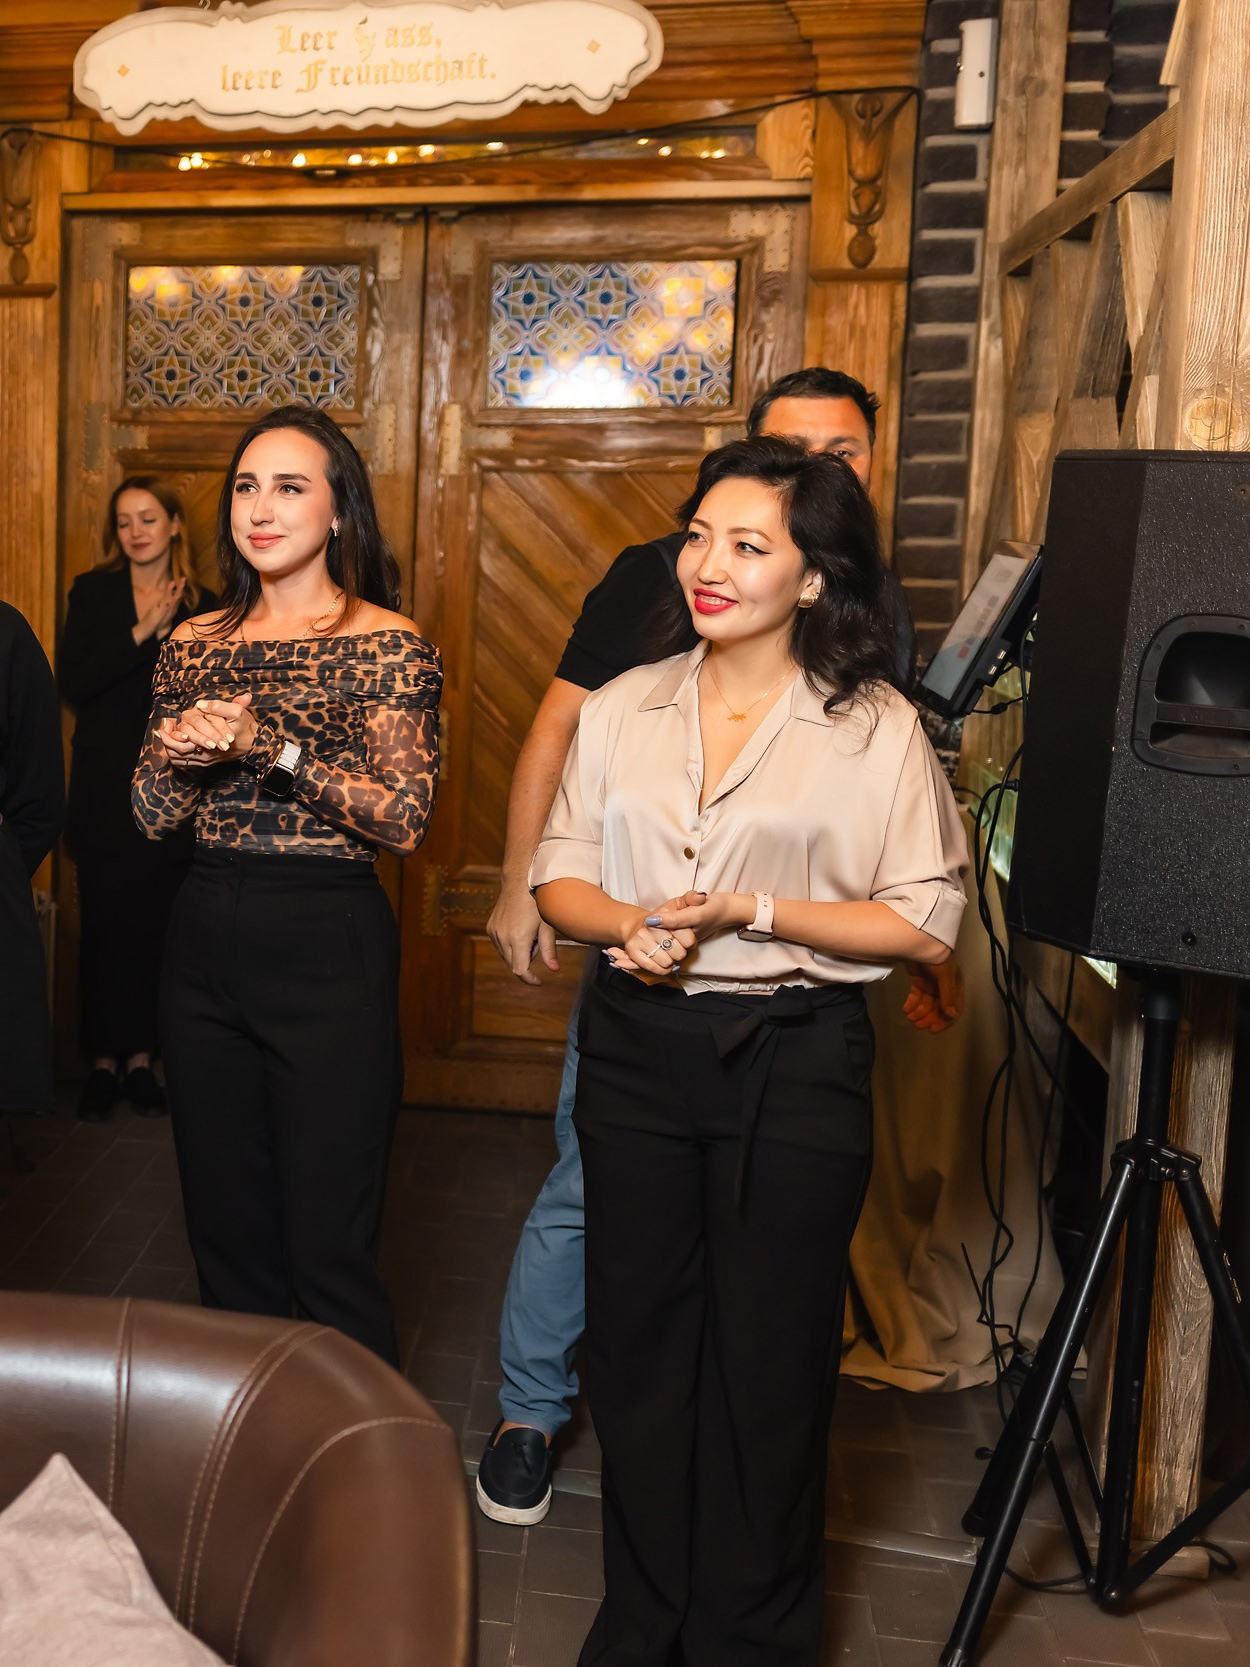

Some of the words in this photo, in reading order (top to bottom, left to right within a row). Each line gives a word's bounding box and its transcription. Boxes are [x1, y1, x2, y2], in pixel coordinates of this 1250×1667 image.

[274, 24, 338, 54] Leer
[221, 64, 282, 92] leere
[295, 52, 497, 94] Freundschaft.
